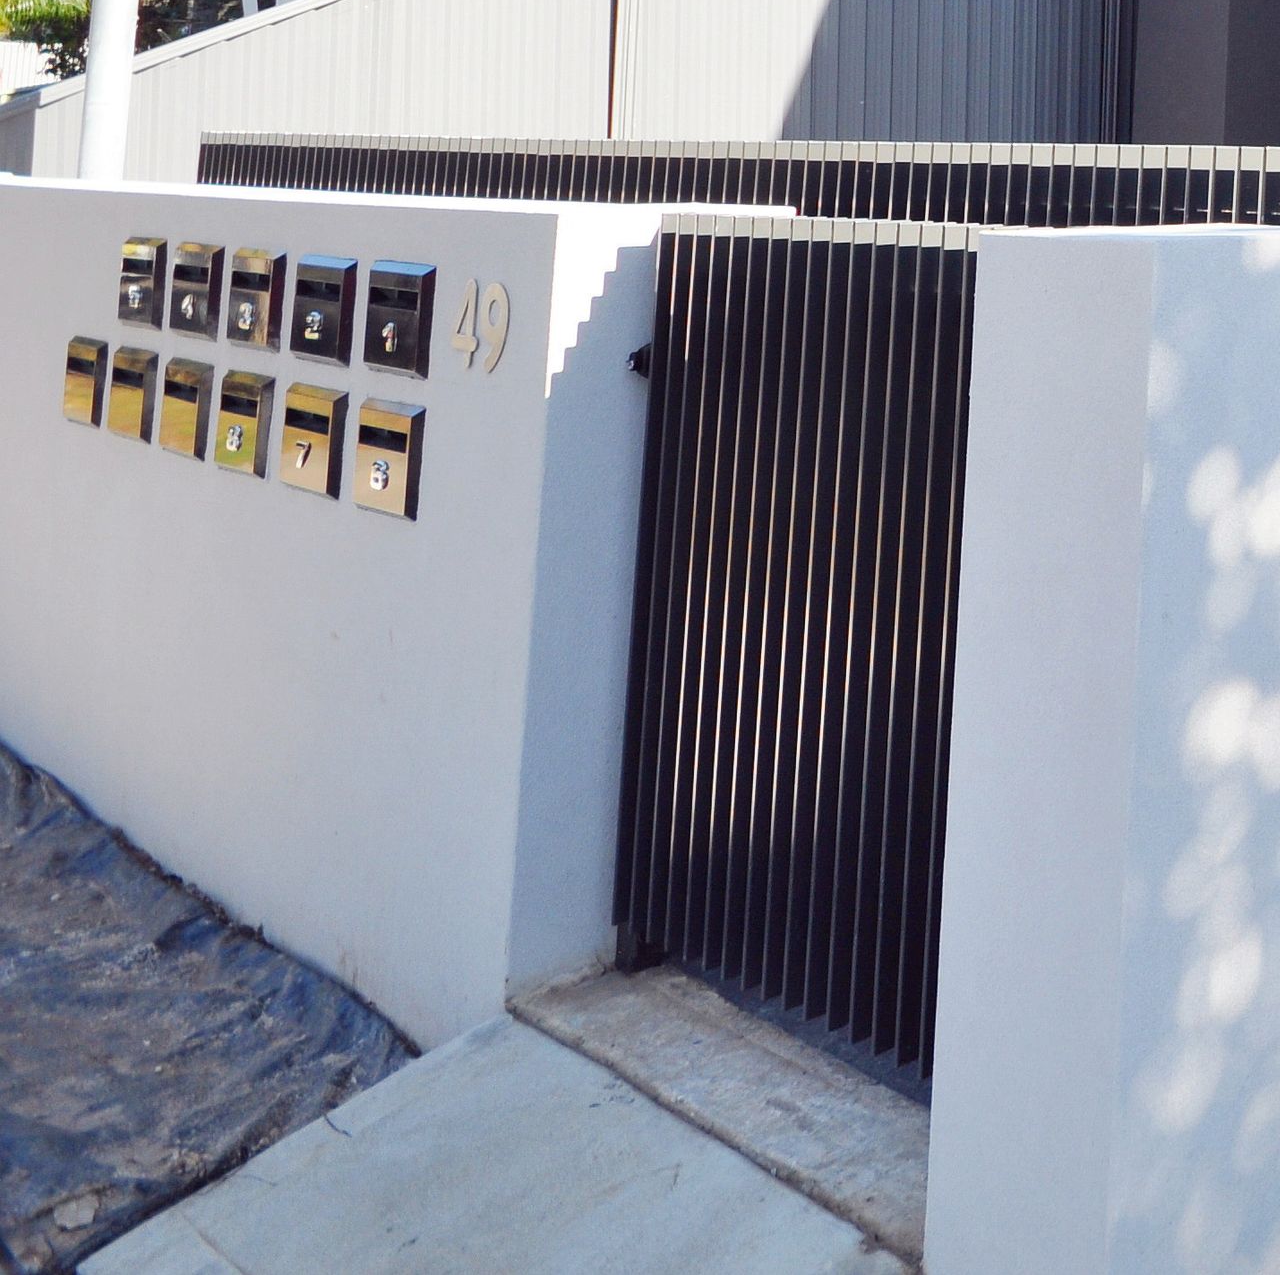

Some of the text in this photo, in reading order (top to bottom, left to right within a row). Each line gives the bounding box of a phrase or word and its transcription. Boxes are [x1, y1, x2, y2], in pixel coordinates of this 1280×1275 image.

[127, 284, 141, 309] 5
[181, 293, 194, 320] 4
[304, 310, 324, 340] 2
[381, 322, 398, 353] 1
[451, 278, 510, 373] 49
[226, 425, 243, 452] 8
[295, 440, 312, 469] 7
